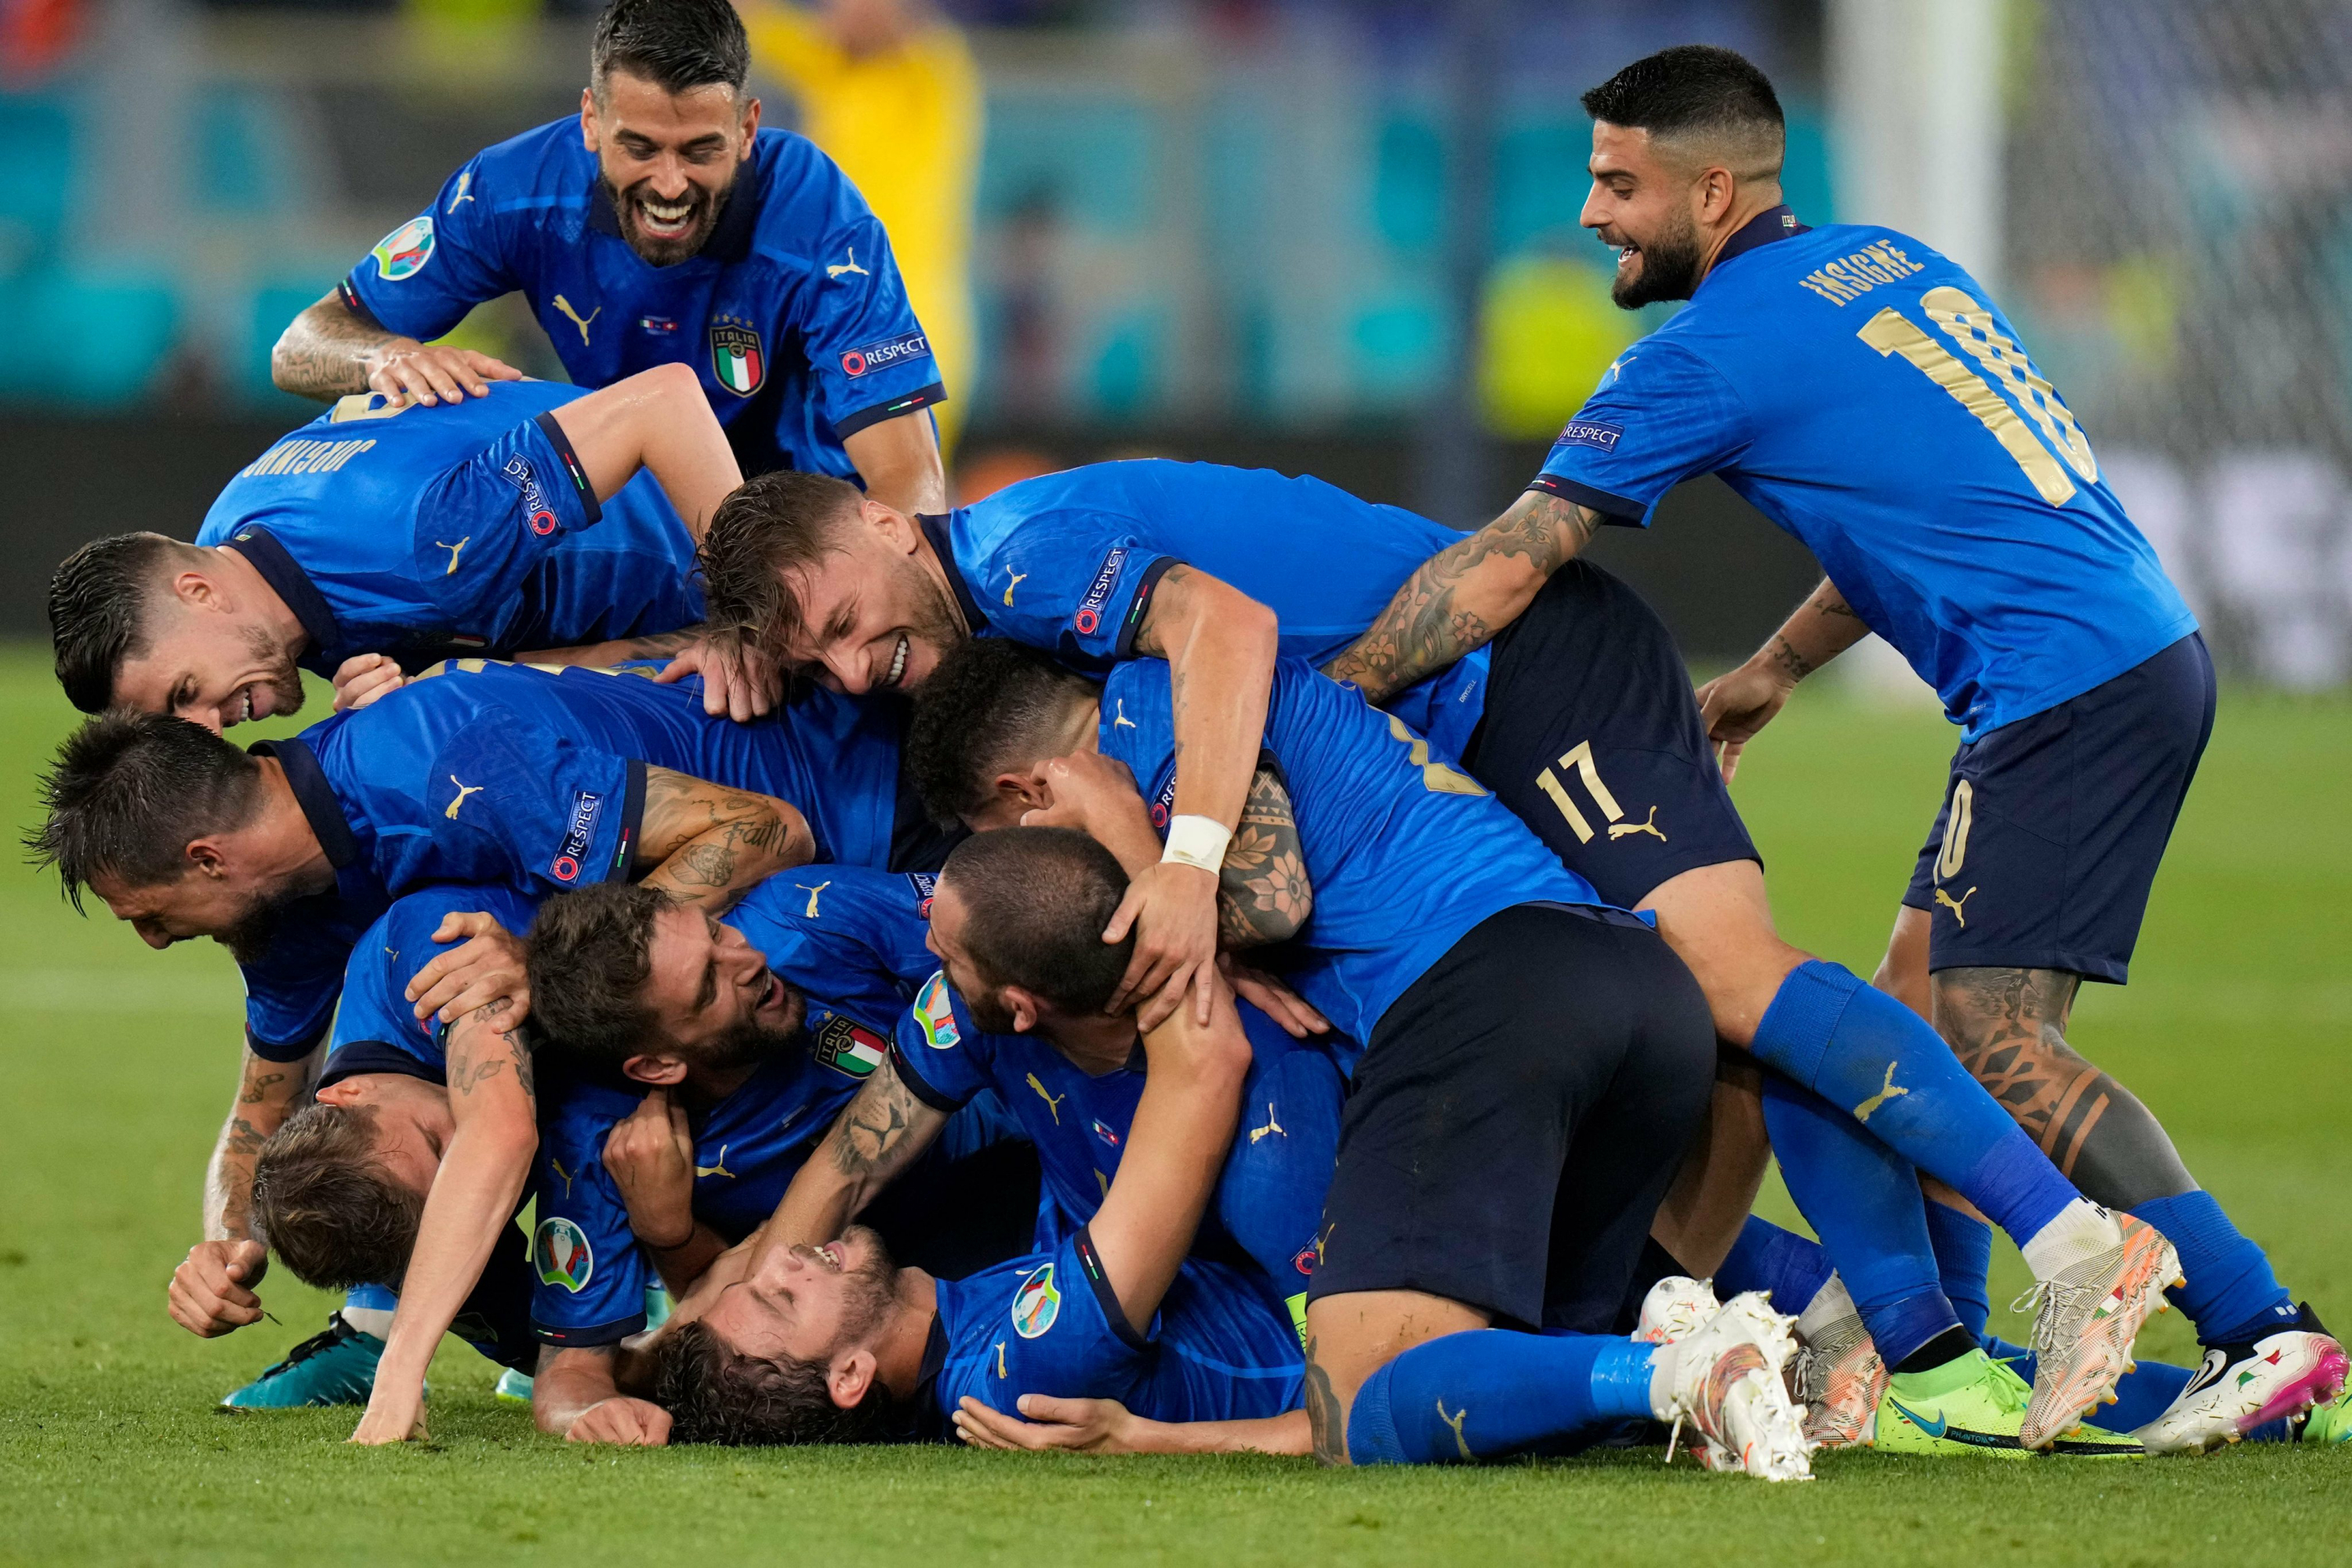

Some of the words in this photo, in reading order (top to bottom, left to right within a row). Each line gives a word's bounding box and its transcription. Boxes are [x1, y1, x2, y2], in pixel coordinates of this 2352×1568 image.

[1798, 239, 1926, 307] INSIGNE
[715, 331, 756, 345] ITALIA
[865, 336, 924, 365] RESPECT
[1856, 286, 2099, 508] 10
[1563, 426, 1621, 445] RESPECT
[1086, 549, 1122, 608] RESPECT
[1459, 680, 1477, 702] DRYCELL
[1535, 739, 1624, 844] 17
[566, 791, 596, 857] RESPECT
[713, 816, 797, 857] Faith
[1933, 779, 1973, 886] 0
[2009, 978, 2022, 987] 24
[821, 1020, 849, 1061] ITALIA
[1950, 1430, 1988, 1443] PHANTOM
